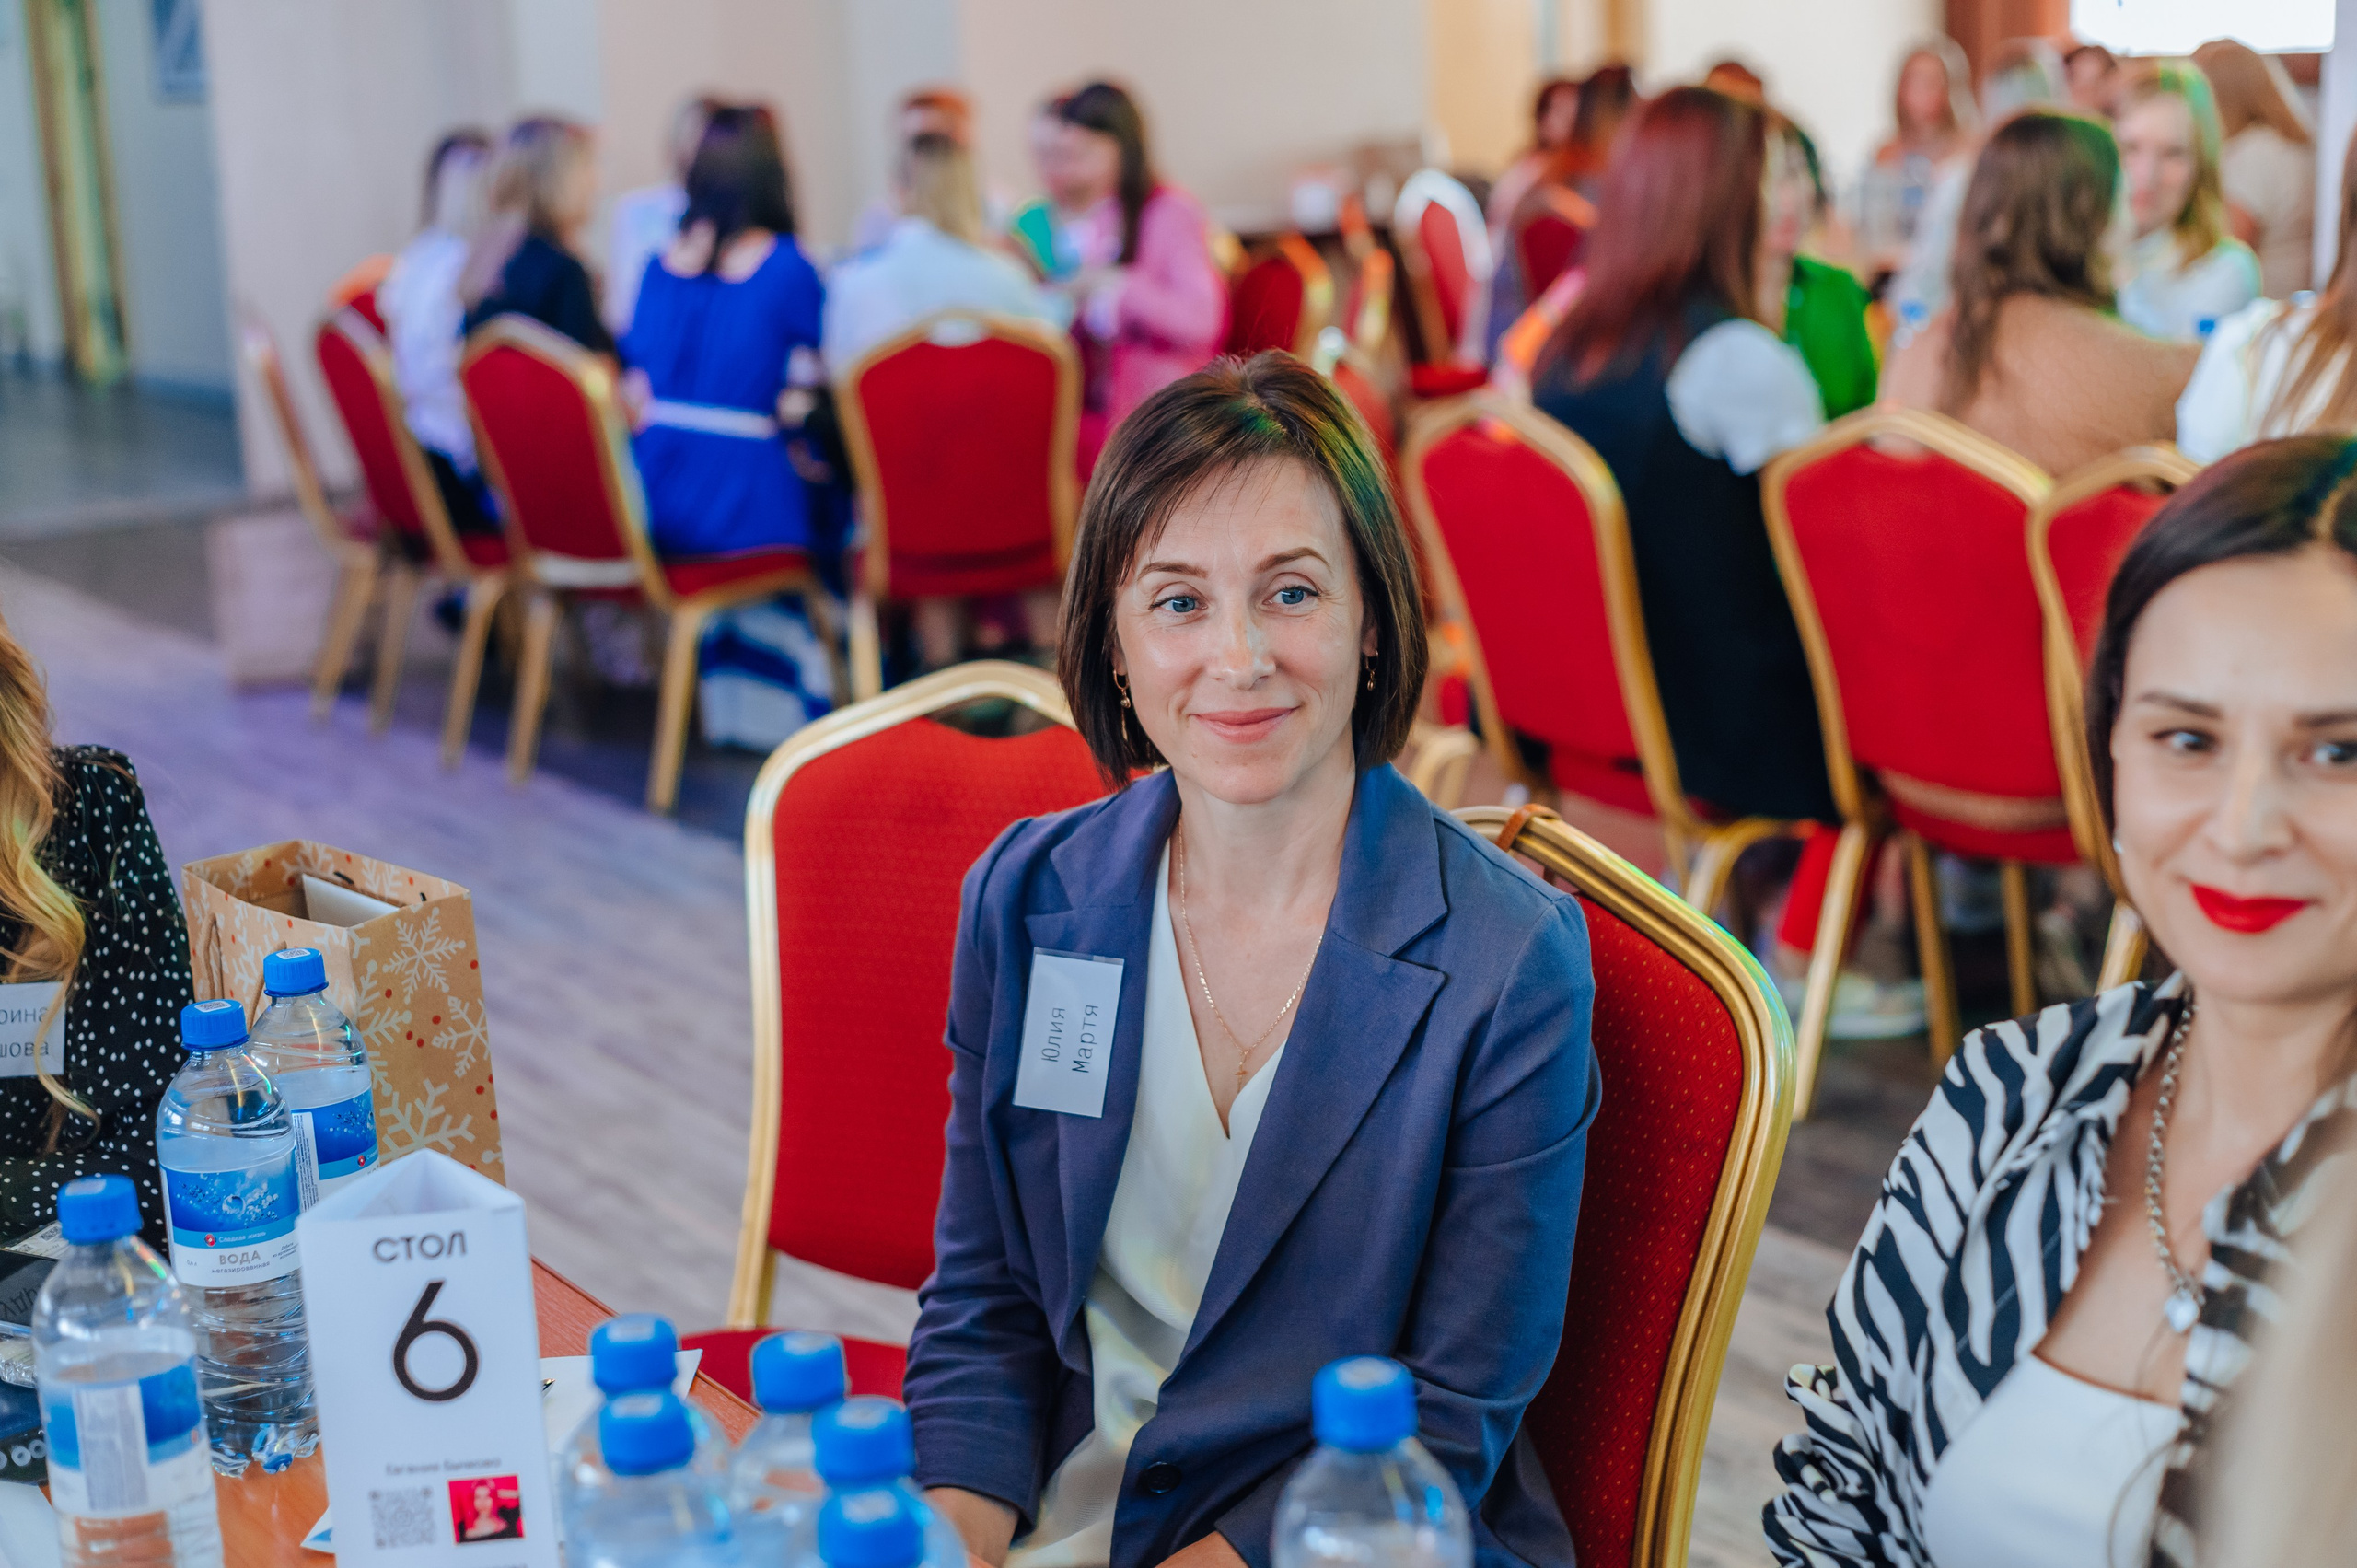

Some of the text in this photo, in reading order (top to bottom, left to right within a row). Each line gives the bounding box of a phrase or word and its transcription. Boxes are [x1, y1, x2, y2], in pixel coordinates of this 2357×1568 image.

[1041, 1007, 1066, 1063] Юлия
[1072, 1005, 1099, 1074] Мартя
[211, 1261, 271, 1274] негазированная
[219, 1250, 261, 1265] ВОДА
[373, 1231, 468, 1263] СТОЛ
[392, 1278, 480, 1402] 6
